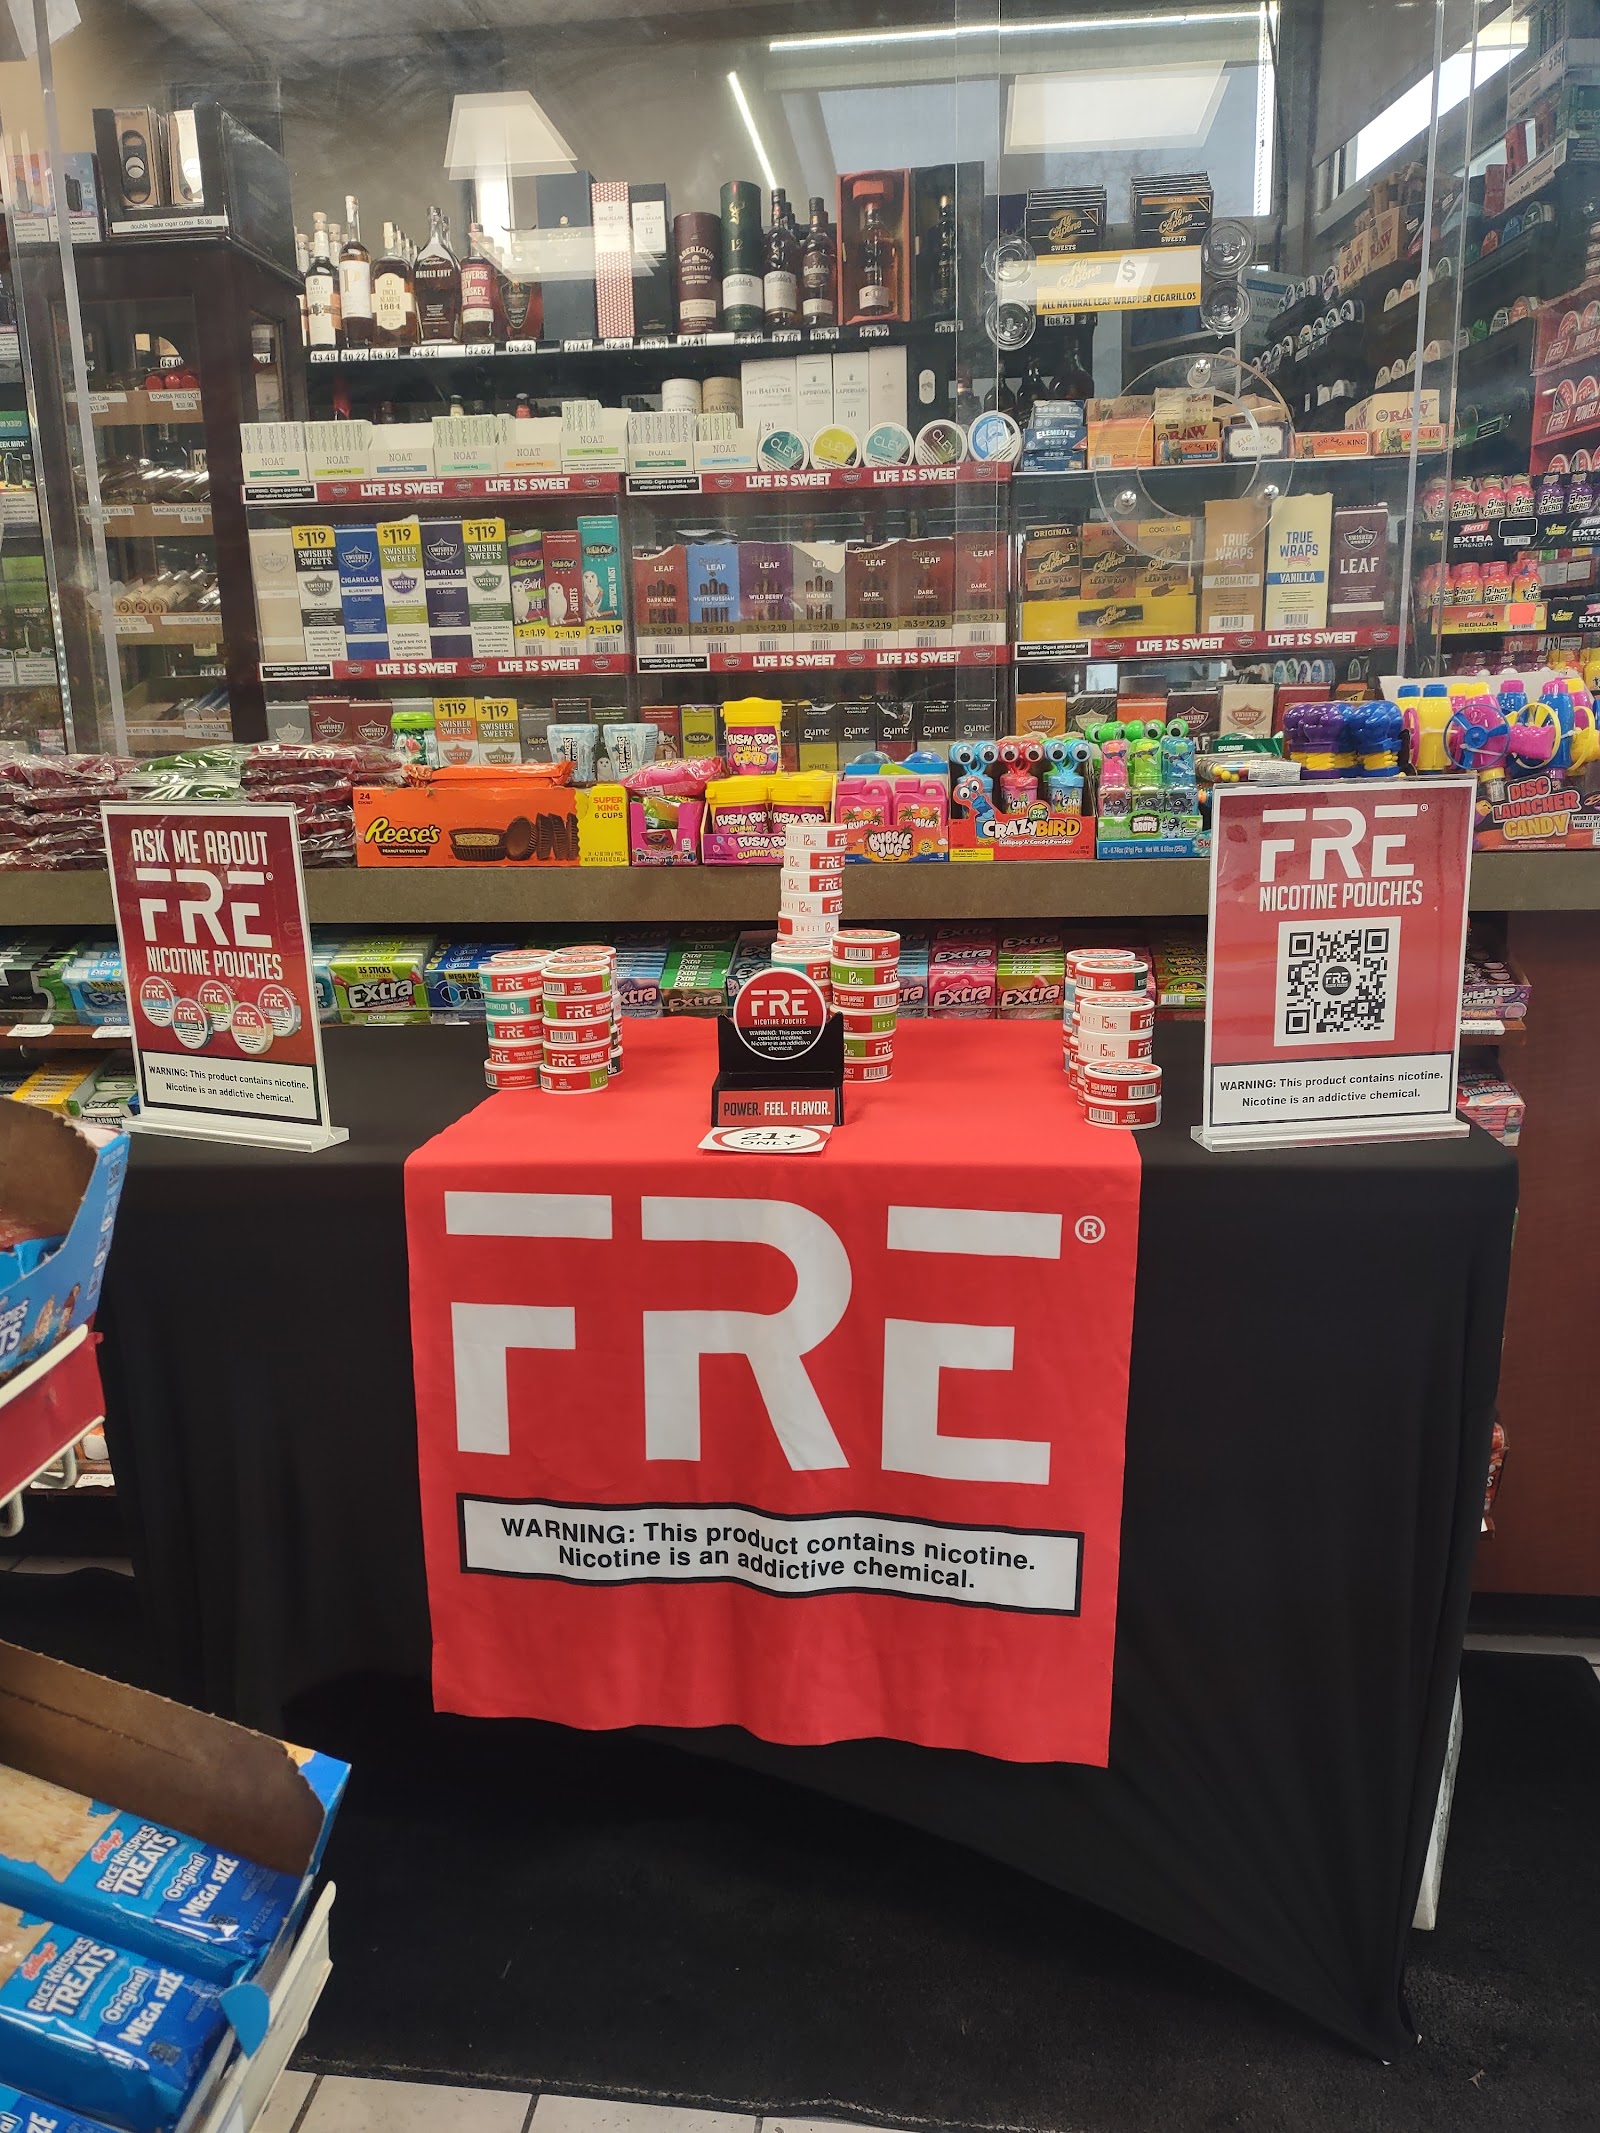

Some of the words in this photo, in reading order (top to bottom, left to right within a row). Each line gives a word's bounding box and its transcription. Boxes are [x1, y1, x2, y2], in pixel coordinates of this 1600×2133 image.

[679, 246, 715, 261] ABERLOUR
[1122, 260, 1136, 282] $
[1042, 302, 1056, 310] ALL
[1057, 299, 1092, 308] NATURAL
[1094, 297, 1112, 306] LEAF
[1114, 295, 1151, 304] WRAPPER
[1154, 292, 1196, 303] CIGARILLOS
[580, 434, 604, 444] NOAT
[1167, 424, 1208, 440] RAW
[326, 456, 350, 464] NOAT
[453, 451, 478, 460] NOAT
[746, 476, 772, 488] LIFE
[774, 475, 788, 486] IS
[790, 472, 832, 486] SWEET
[1034, 529, 1071, 537] ORIGINAL
[1286, 531, 1313, 543] TRUE
[1453, 535, 1493, 543] EXTRA
[298, 550, 333, 558] SWISHER
[1280, 544, 1319, 557] WRAPS
[1340, 557, 1379, 574] LEAF
[1213, 575, 1254, 586] AROMATIC
[1280, 572, 1316, 583] VANILLA
[1268, 634, 1295, 646] LIFE
[1297, 633, 1312, 645] IS
[1315, 631, 1357, 644] SWEET
[727, 733, 753, 745] PUSH
[755, 733, 776, 745] POP
[804, 728, 830, 741] game
[923, 724, 949, 739] game
[1217, 744, 1244, 752] SPEARMINT
[360, 792, 370, 800] 24
[1509, 777, 1549, 801] DISC
[1493, 791, 1579, 821] LAUNCHER
[716, 812, 747, 826] PUSH
[748, 810, 768, 824] POP
[1504, 813, 1568, 838] CANDY
[364, 816, 442, 844] Reese's
[131, 829, 170, 863] ASK
[171, 829, 201, 864] ME
[204, 830, 268, 866] ABOUT
[869, 832, 913, 849] BUBBLE
[1259, 803, 1418, 883] FRE
[737, 851, 770, 860] GUMMY
[878, 842, 900, 857] JUG
[1259, 883, 1338, 912] NICOTINE
[1342, 879, 1423, 908] POUCHES
[136, 867, 272, 948] FRE
[146, 946, 211, 976] NICOTINE
[213, 950, 283, 981] POUCHES
[358, 966, 365, 974] 35
[366, 966, 391, 975] STICKS
[448, 973, 465, 981] MEGA
[497, 977, 524, 991] FRE
[1325, 972, 1349, 985] FRE
[349, 979, 413, 1009] Extra
[933, 985, 991, 1008] Extra
[1000, 984, 1061, 1011] Extra
[750, 989, 810, 1017] FRE
[566, 1005, 594, 1019] FRE
[791, 1029, 811, 1037] product
[551, 1054, 578, 1067] FRE
[149, 1065, 188, 1078] WARNING:
[189, 1069, 206, 1080] This
[208, 1072, 237, 1084] product
[239, 1075, 273, 1087] contains
[274, 1078, 309, 1090] nicotine.
[1219, 1078, 1277, 1092] WARNING:
[1279, 1077, 1302, 1088] This
[1305, 1074, 1347, 1089] product
[1349, 1071, 1395, 1084] contains
[1397, 1069, 1444, 1082] nicotine.
[166, 1082, 197, 1094] Nicotine
[199, 1085, 206, 1094] is
[208, 1086, 217, 1095] an
[219, 1087, 254, 1099] addictive
[256, 1090, 294, 1103] chemical.
[1242, 1094, 1287, 1107] Nicotine
[1290, 1094, 1299, 1105] is
[1301, 1094, 1315, 1104] an
[1317, 1089, 1367, 1102] addictive
[1369, 1087, 1421, 1100] chemical.
[723, 1102, 761, 1116] POWER.
[764, 1102, 788, 1116] FEEL.
[791, 1101, 831, 1115] FLAVOR.
[444, 1191, 1062, 1485] FRE
[501, 1517, 638, 1544] WARNING:
[643, 1521, 699, 1543] This
[706, 1522, 800, 1556] product
[806, 1528, 916, 1559] contains
[924, 1540, 1037, 1572] nicotine.
[558, 1543, 660, 1569] Nicotine
[669, 1543, 691, 1566] is
[698, 1548, 729, 1566] an
[736, 1548, 846, 1580] addictive
[852, 1555, 976, 1590] chemical.
[96, 1864, 120, 1892] RICE
[111, 1825, 157, 1866] KRISPIES
[113, 1833, 177, 1896] TREATS
[166, 1855, 207, 1899] Original
[178, 1883, 222, 1917] MEGA
[211, 1854, 239, 1883] SIZE
[46, 1947, 117, 2015] TREATS
[104, 1970, 149, 2022] Original
[117, 2001, 166, 2046] MEGA
[155, 1968, 184, 2000] SIZE
